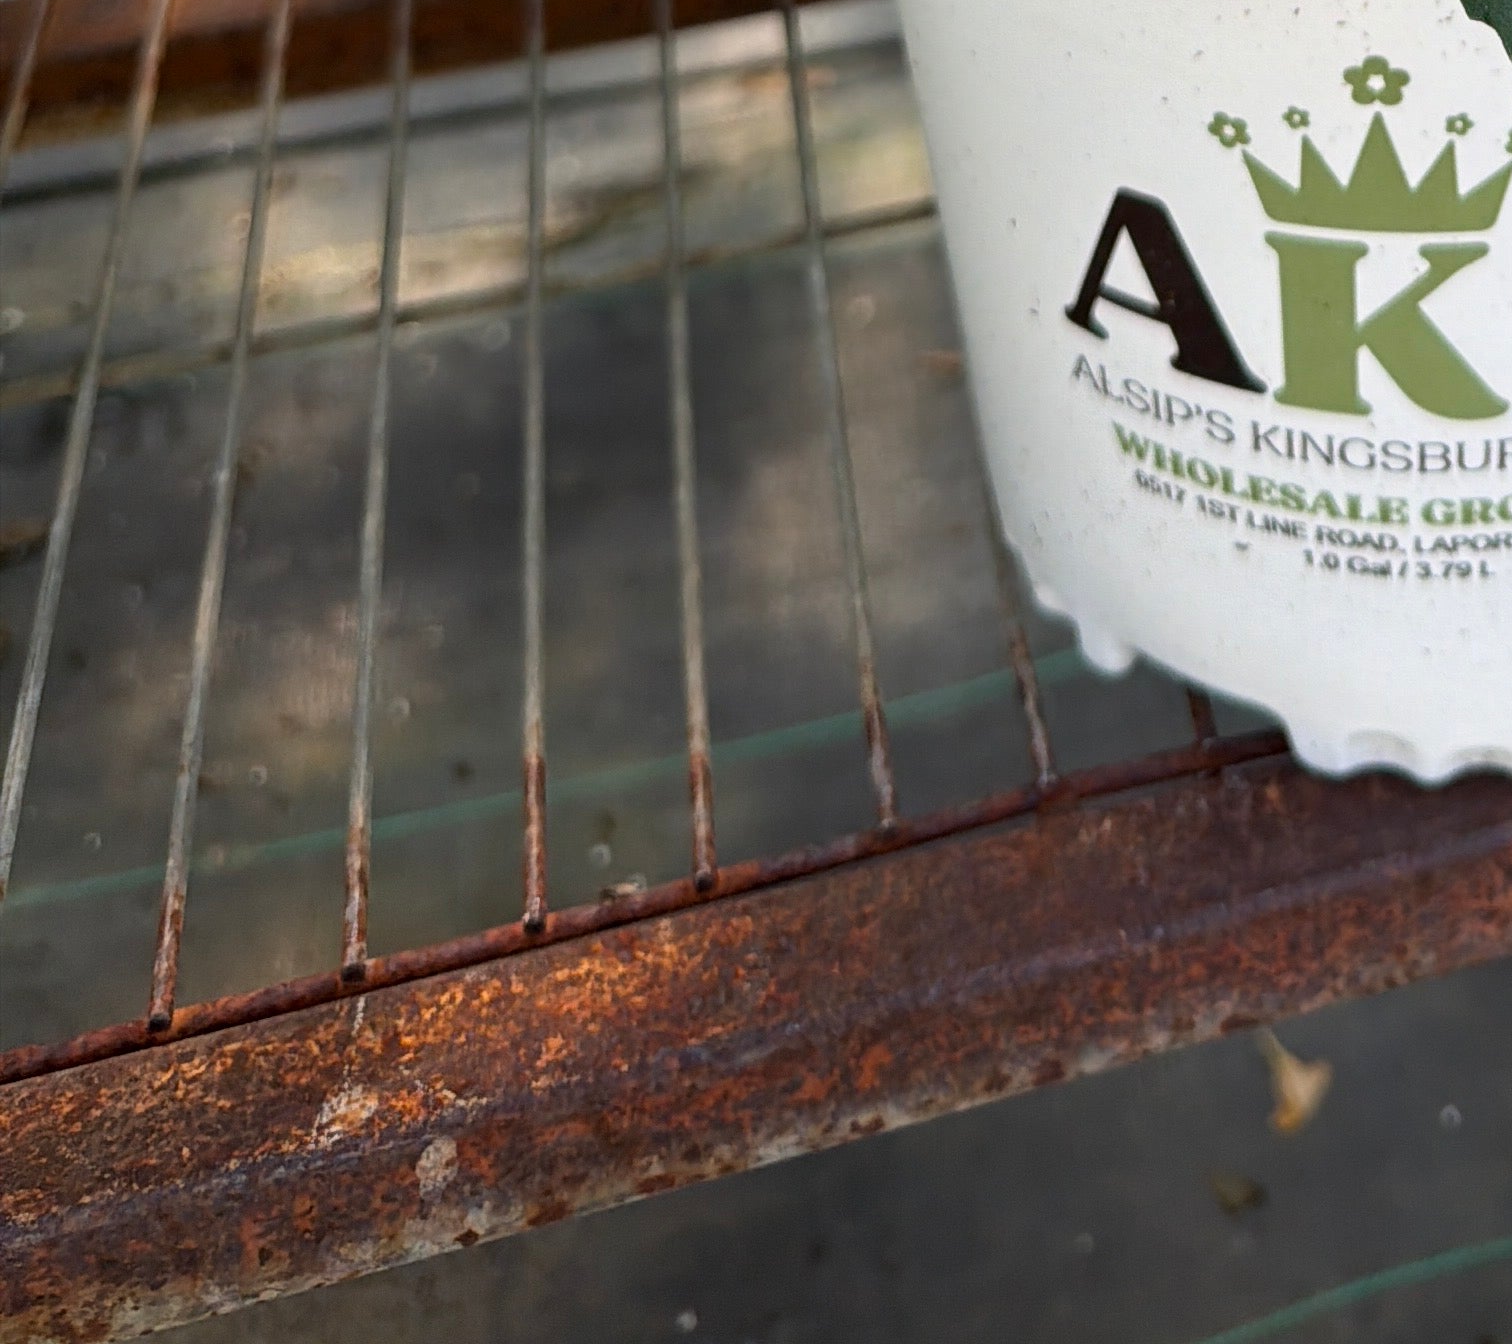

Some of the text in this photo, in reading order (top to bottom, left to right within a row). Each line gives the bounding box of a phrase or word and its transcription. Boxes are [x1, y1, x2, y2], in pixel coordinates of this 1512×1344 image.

[1073, 354, 1236, 444] ALSIP'S
[1112, 421, 1411, 526] WHOLESALE
[1195, 493, 1242, 523] 1ST
[1246, 509, 1308, 539] LINE
[1314, 523, 1407, 555] ROAD,
[1346, 554, 1392, 577] Gal
[1416, 559, 1473, 580] 3.79
